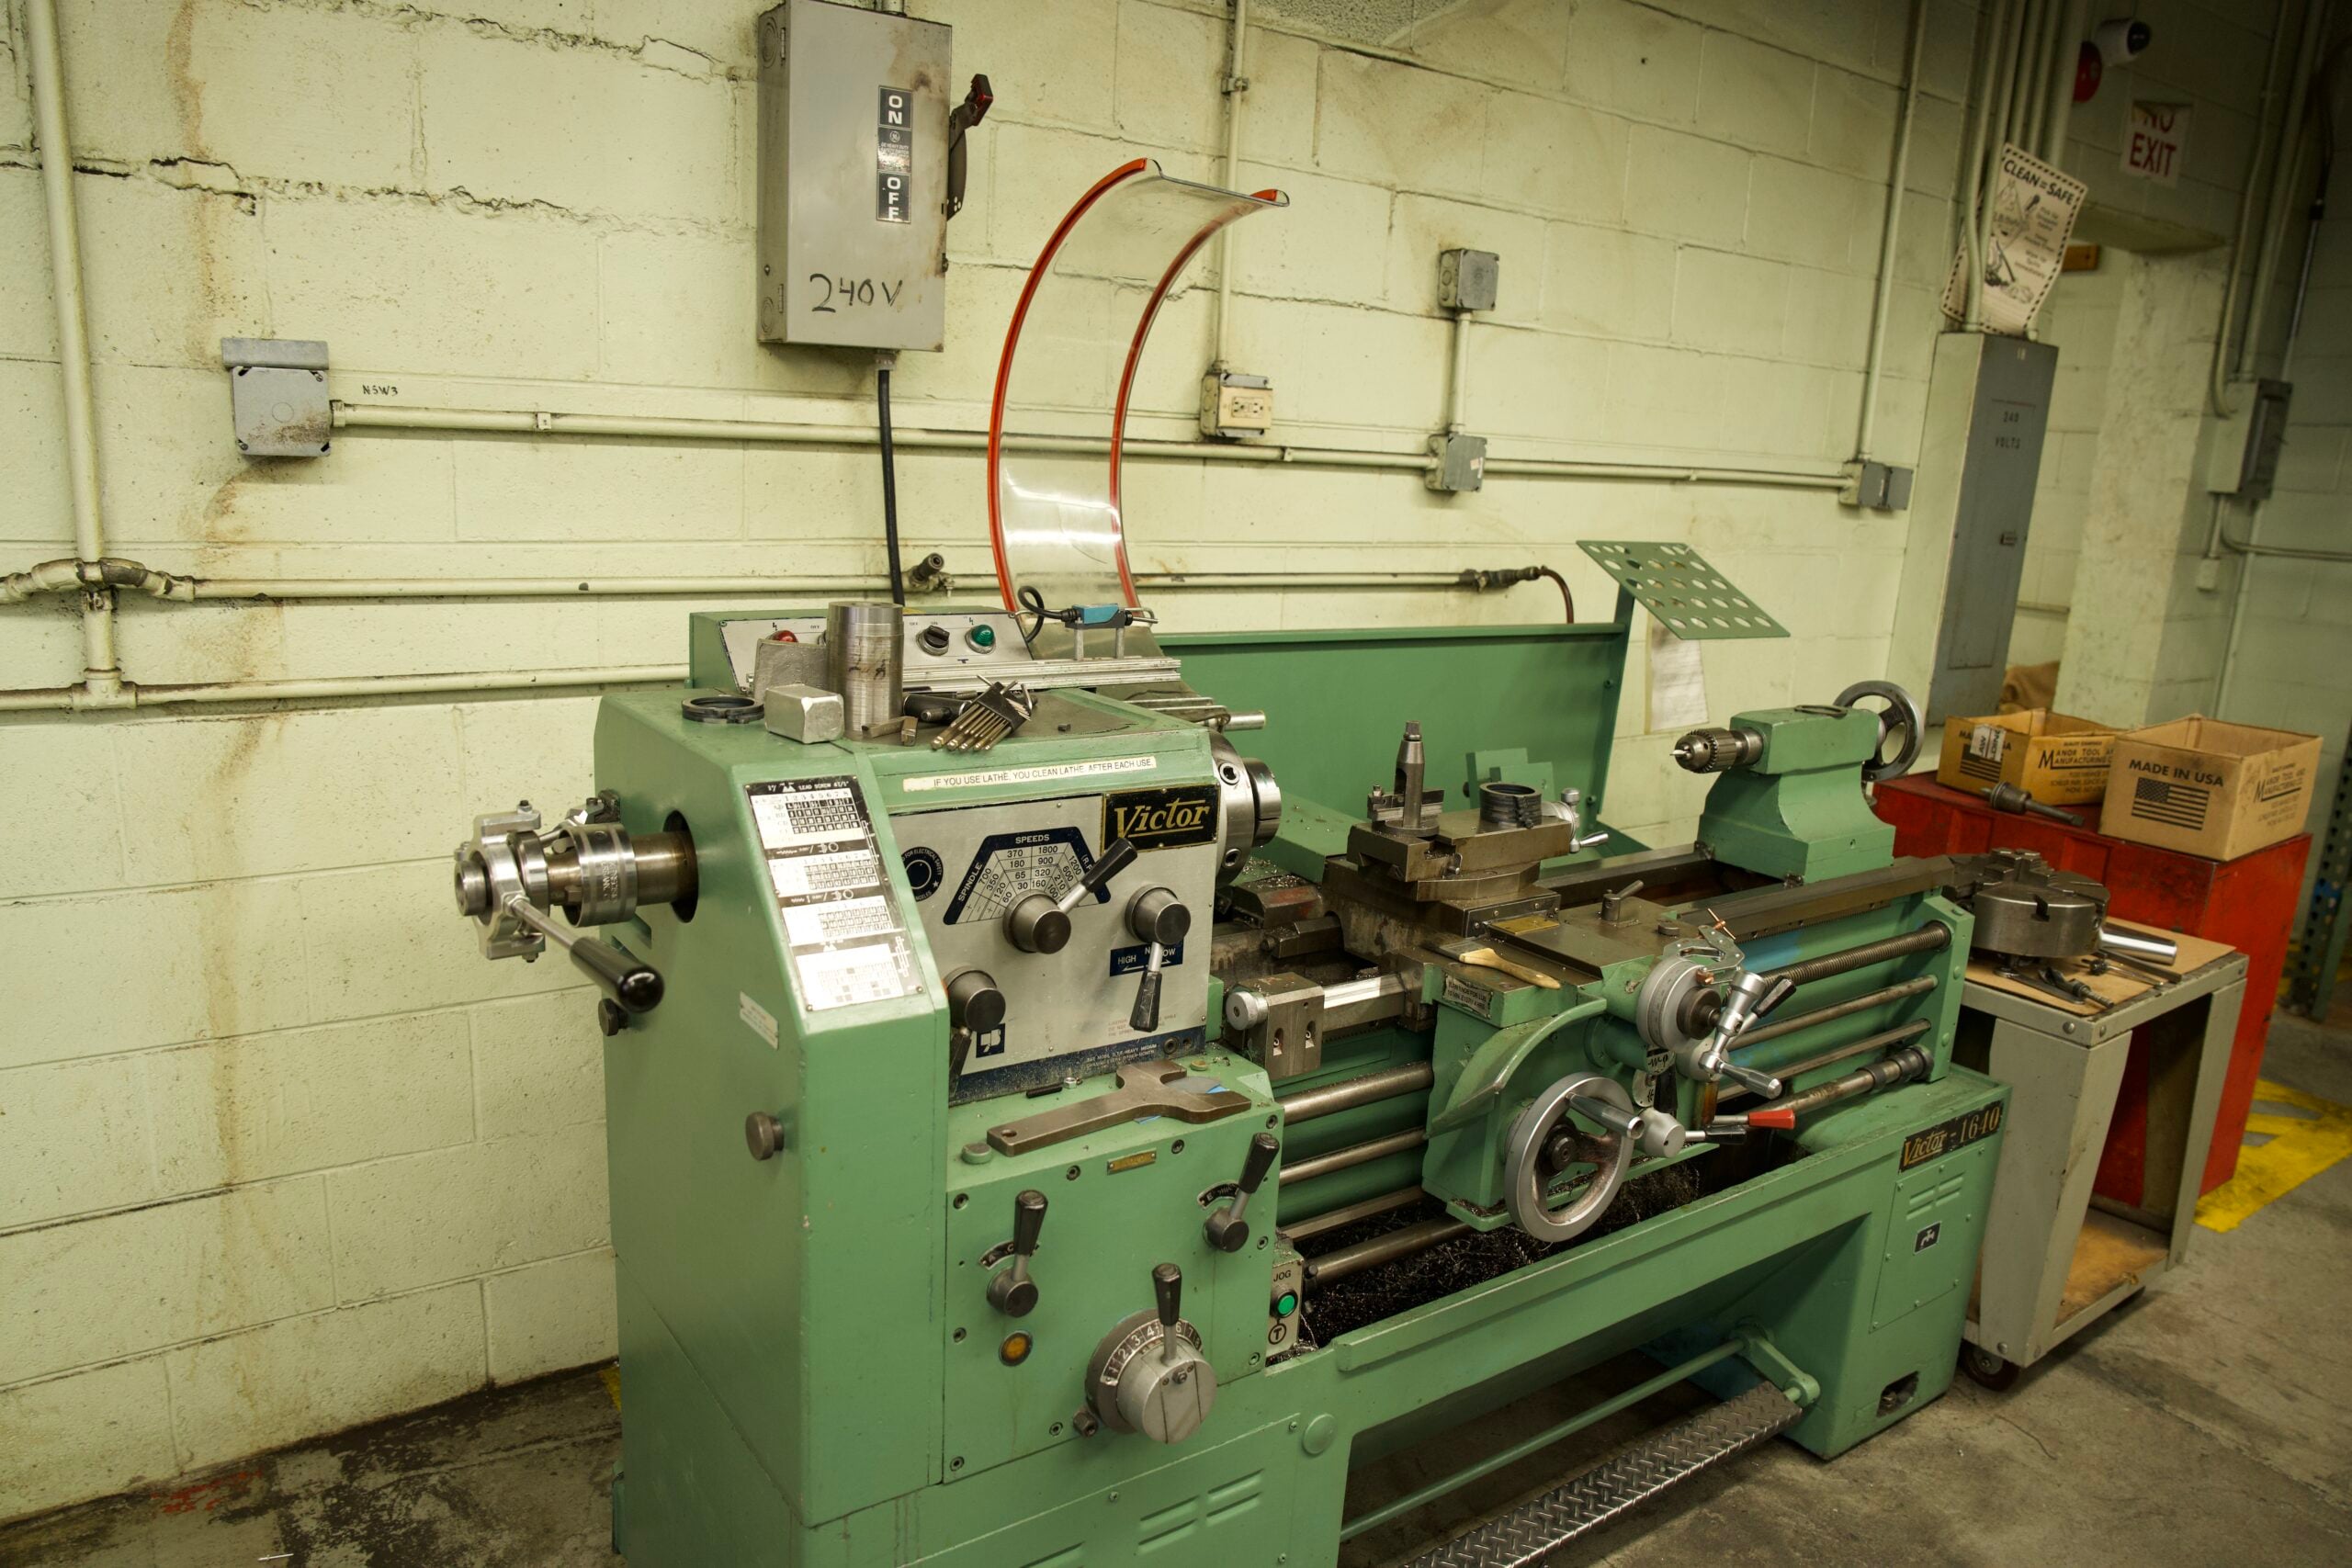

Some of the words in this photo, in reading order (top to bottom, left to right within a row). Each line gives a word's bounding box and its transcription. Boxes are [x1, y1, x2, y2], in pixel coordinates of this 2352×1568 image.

[888, 95, 903, 125] ON
[2130, 131, 2176, 177] EXIT
[2004, 160, 2040, 186] CLEAN
[2047, 183, 2075, 206] SAFE
[887, 176, 901, 220] OFF
[1996, 436, 2020, 449] VOLTS
[1959, 730, 1973, 740] MA
[2082, 749, 2100, 757] TOOL
[933, 778, 941, 787] IF
[944, 777, 961, 786] YOU
[964, 775, 980, 784] USE
[1013, 770, 1030, 780] YOU
[1032, 768, 1057, 779] CLEAN
[1089, 762, 1113, 773] AFTER
[1114, 761, 1135, 770] EACH
[2129, 760, 2169, 776] MADE
[2174, 768, 2190, 780] IN
[2195, 772, 2223, 787] USA
[1114, 797, 1210, 838] Victor
[1015, 834, 1050, 844] SPEEDS
[1007, 850, 1023, 858] 370
[1038, 846, 1058, 854] 1800
[1069, 855, 1082, 875] 1200
[978, 867, 992, 885] 700
[1015, 871, 1026, 879] 65
[1062, 865, 1074, 882] 600
[958, 863, 982, 902] SPINDLE
[986, 874, 1000, 891] 350
[994, 882, 1006, 898] 120
[1017, 882, 1028, 890] 30
[1032, 880, 1046, 888] 160
[1055, 874, 1066, 891] 210
[1002, 892, 1012, 903] 60
[1047, 884, 1058, 898] 100
[1118, 955, 1136, 964] HIGH
[1162, 948, 1176, 957] OW
[1904, 1130, 1948, 1167] Victor
[1960, 1106, 2000, 1143] 1640
[1273, 1269, 1292, 1282] JOG
[1147, 1325, 1155, 1337] 4
[1176, 1321, 1182, 1333] 6
[1188, 1326, 1194, 1337] 7
[1131, 1335, 1140, 1346] 3
[1118, 1348, 1129, 1359] 2
